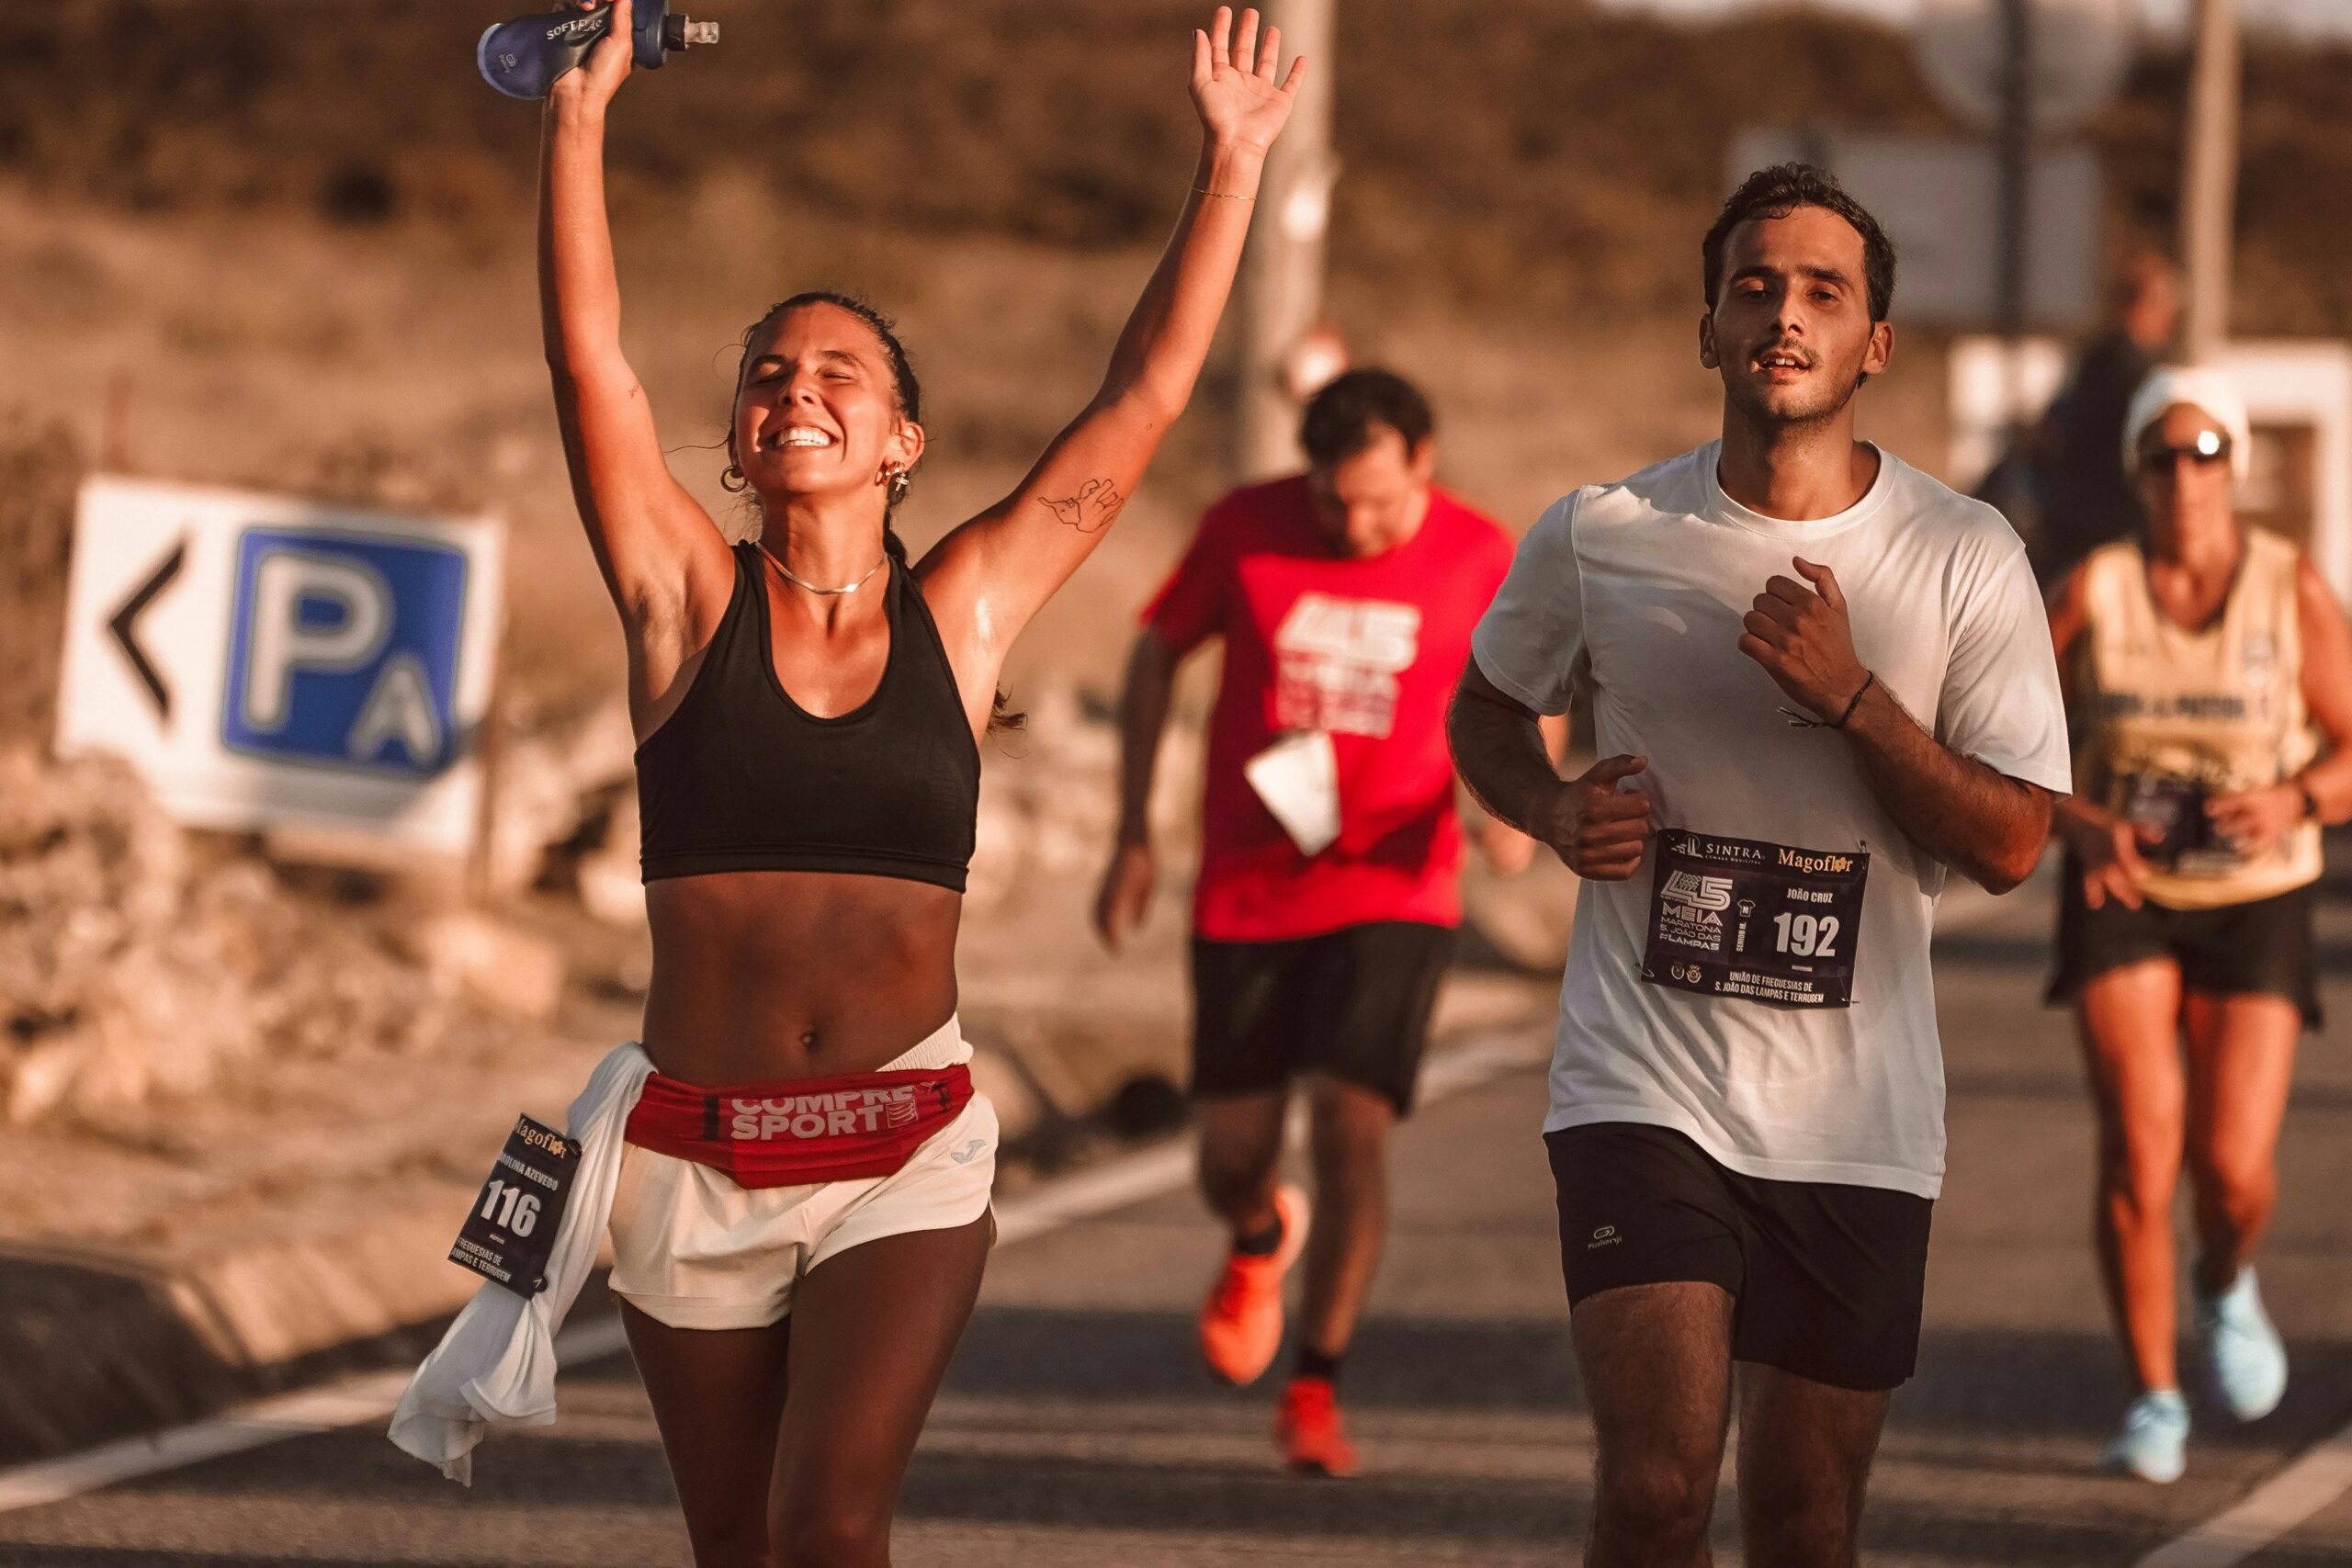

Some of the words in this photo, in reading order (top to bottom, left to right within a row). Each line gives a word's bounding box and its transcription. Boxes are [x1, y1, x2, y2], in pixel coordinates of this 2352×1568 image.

[245, 549, 390, 728] P
[1706, 843, 1761, 860] SINTRA
[1787, 887, 1810, 902] JOÃO
[1810, 891, 1834, 904] CRUZ
[1662, 901, 1723, 926] MEIA
[1661, 917, 1722, 934] MARATONA
[1670, 927, 1696, 938] JOÃO
[1698, 932, 1721, 942] DAS
[1774, 912, 1839, 957] 192
[1659, 932, 1720, 951] #LAMPAS
[1714, 981, 1722, 991] S.
[1723, 981, 1739, 993] JOÃO
[1740, 984, 1755, 995] DAS
[1756, 987, 1783, 999] LAMPAS
[1783, 991, 1790, 1000] E
[1790, 992, 1824, 1003] TERRUGEM
[1729, 971, 1750, 983] UNIÃO
[1751, 974, 1760, 985] DE
[1761, 976, 1803, 991] FREGUESIAS
[1804, 982, 1813, 992] DE
[730, 1104, 884, 1141] SPORT
[524, 1167, 559, 1191] AZEVEDO
[481, 1179, 541, 1237] 116
[472, 1258, 480, 1267] E
[478, 1260, 512, 1283] TERRUGEM
[492, 1255, 503, 1266] DE
